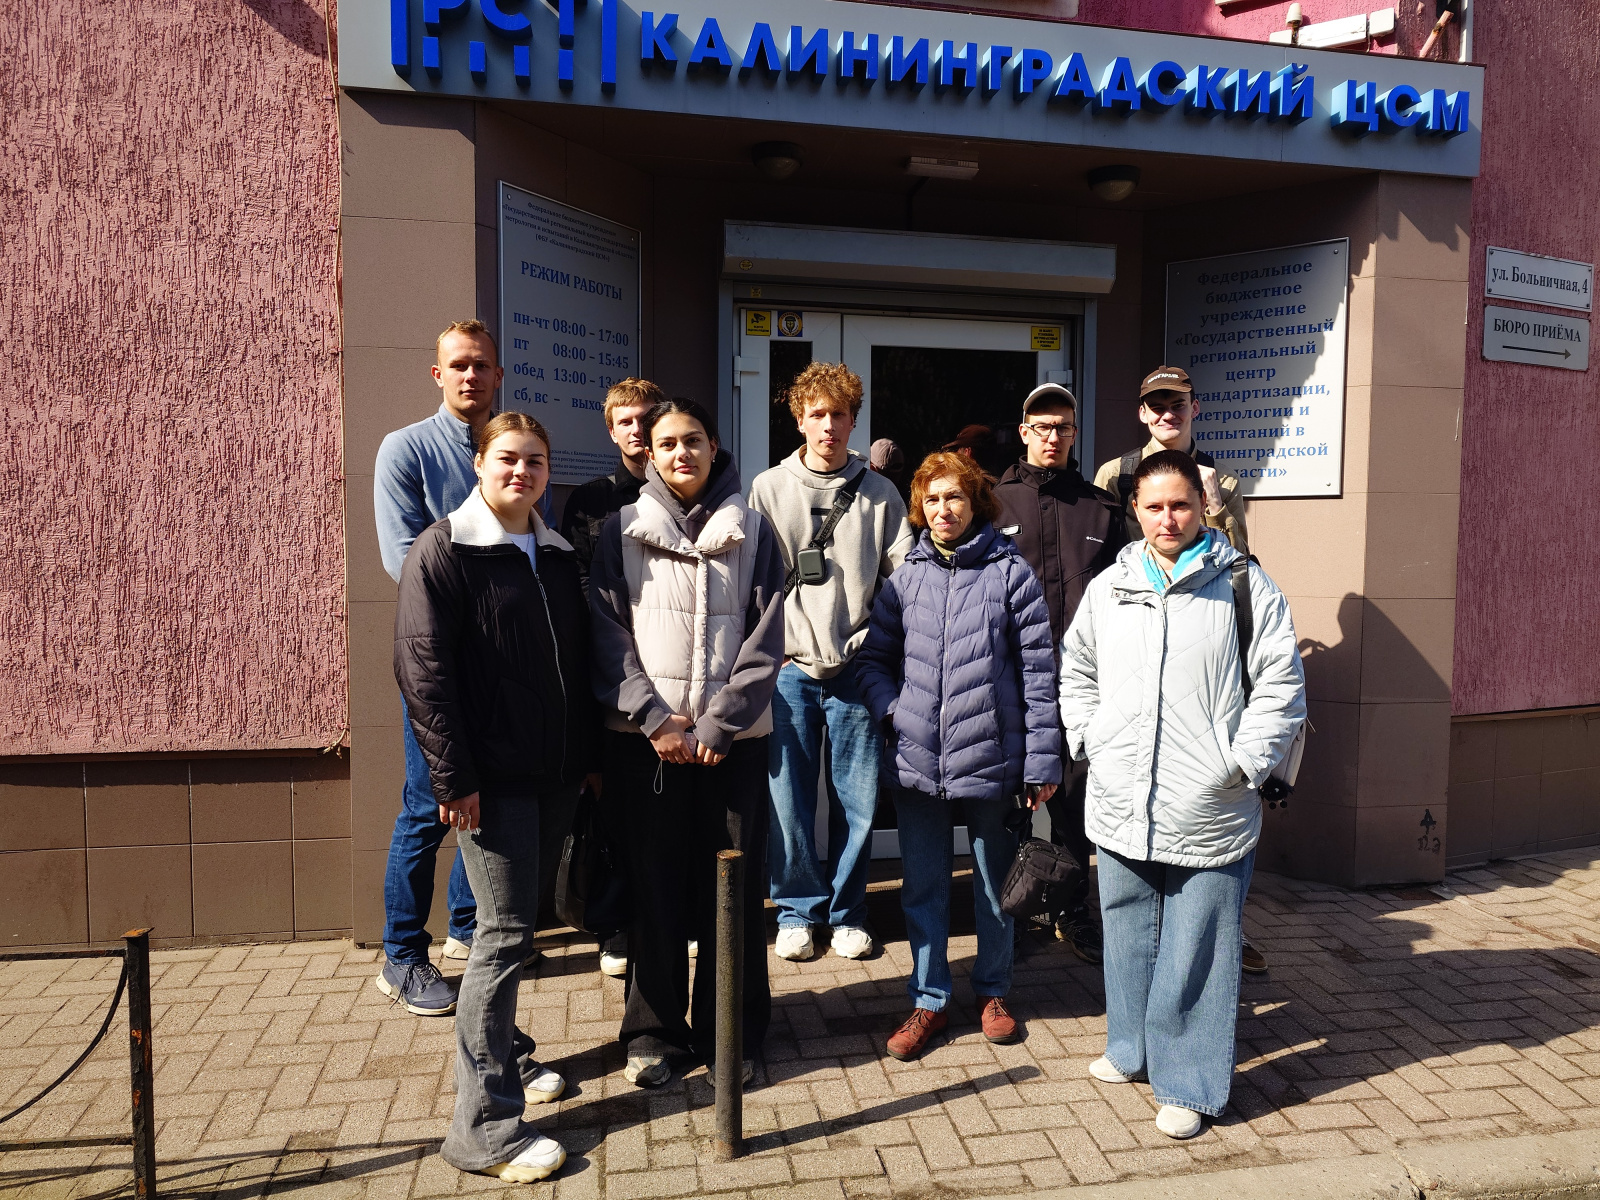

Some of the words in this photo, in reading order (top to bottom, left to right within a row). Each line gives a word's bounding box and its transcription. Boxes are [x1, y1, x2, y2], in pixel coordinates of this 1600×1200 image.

[640, 10, 1316, 120] КАЛИНИНГРАДСКИЙ
[1340, 80, 1470, 133] ЦСМ
[521, 261, 571, 288] РЕЖИМ
[573, 275, 623, 301] РАБОТЫ
[1198, 261, 1313, 286] Федеральное
[1491, 267, 1509, 283] ул.
[1511, 265, 1581, 295] Больничная,
[1581, 278, 1588, 294] 4
[1205, 283, 1302, 305] бюджетное
[1200, 303, 1307, 328] учреждение
[513, 312, 550, 330] пн-чт
[553, 318, 586, 338] 08:00
[598, 328, 629, 346] 17:00
[1175, 318, 1335, 348] «Государственный
[1493, 317, 1530, 336] БЮРО
[1532, 323, 1582, 343] ПРИЁМА
[513, 338, 529, 351] пт
[553, 343, 586, 361] 08:00
[598, 352, 629, 370] 15:45
[1190, 341, 1317, 366] региональный
[513, 362, 545, 381] обед
[553, 367, 587, 385] 13:00
[1225, 367, 1277, 382] центр
[514, 387, 531, 403] сб,
[534, 392, 548, 404] вс
[1194, 383, 1331, 404] тандартизации,
[1193, 406, 1294, 423] метрологии
[1299, 405, 1310, 417] и
[1196, 424, 1290, 443] испытаний
[1295, 425, 1305, 437] в
[1204, 442, 1329, 461] ининградской
[1234, 468, 1288, 480] асти»
